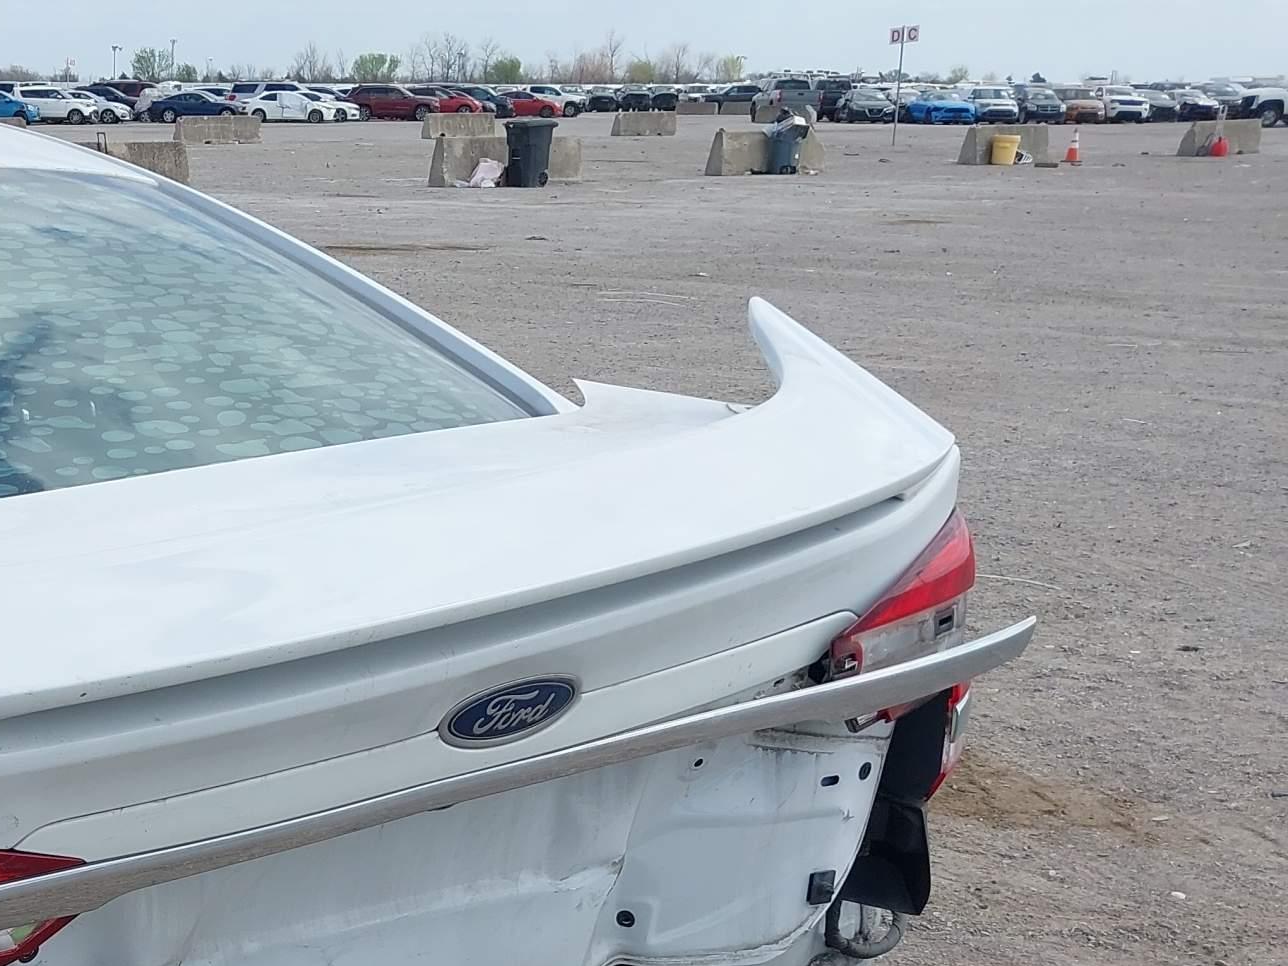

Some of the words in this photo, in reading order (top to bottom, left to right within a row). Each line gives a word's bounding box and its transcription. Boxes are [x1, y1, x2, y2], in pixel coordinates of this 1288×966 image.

[891, 30, 901, 42] D
[907, 27, 918, 41] C
[472, 689, 556, 735] Ford
